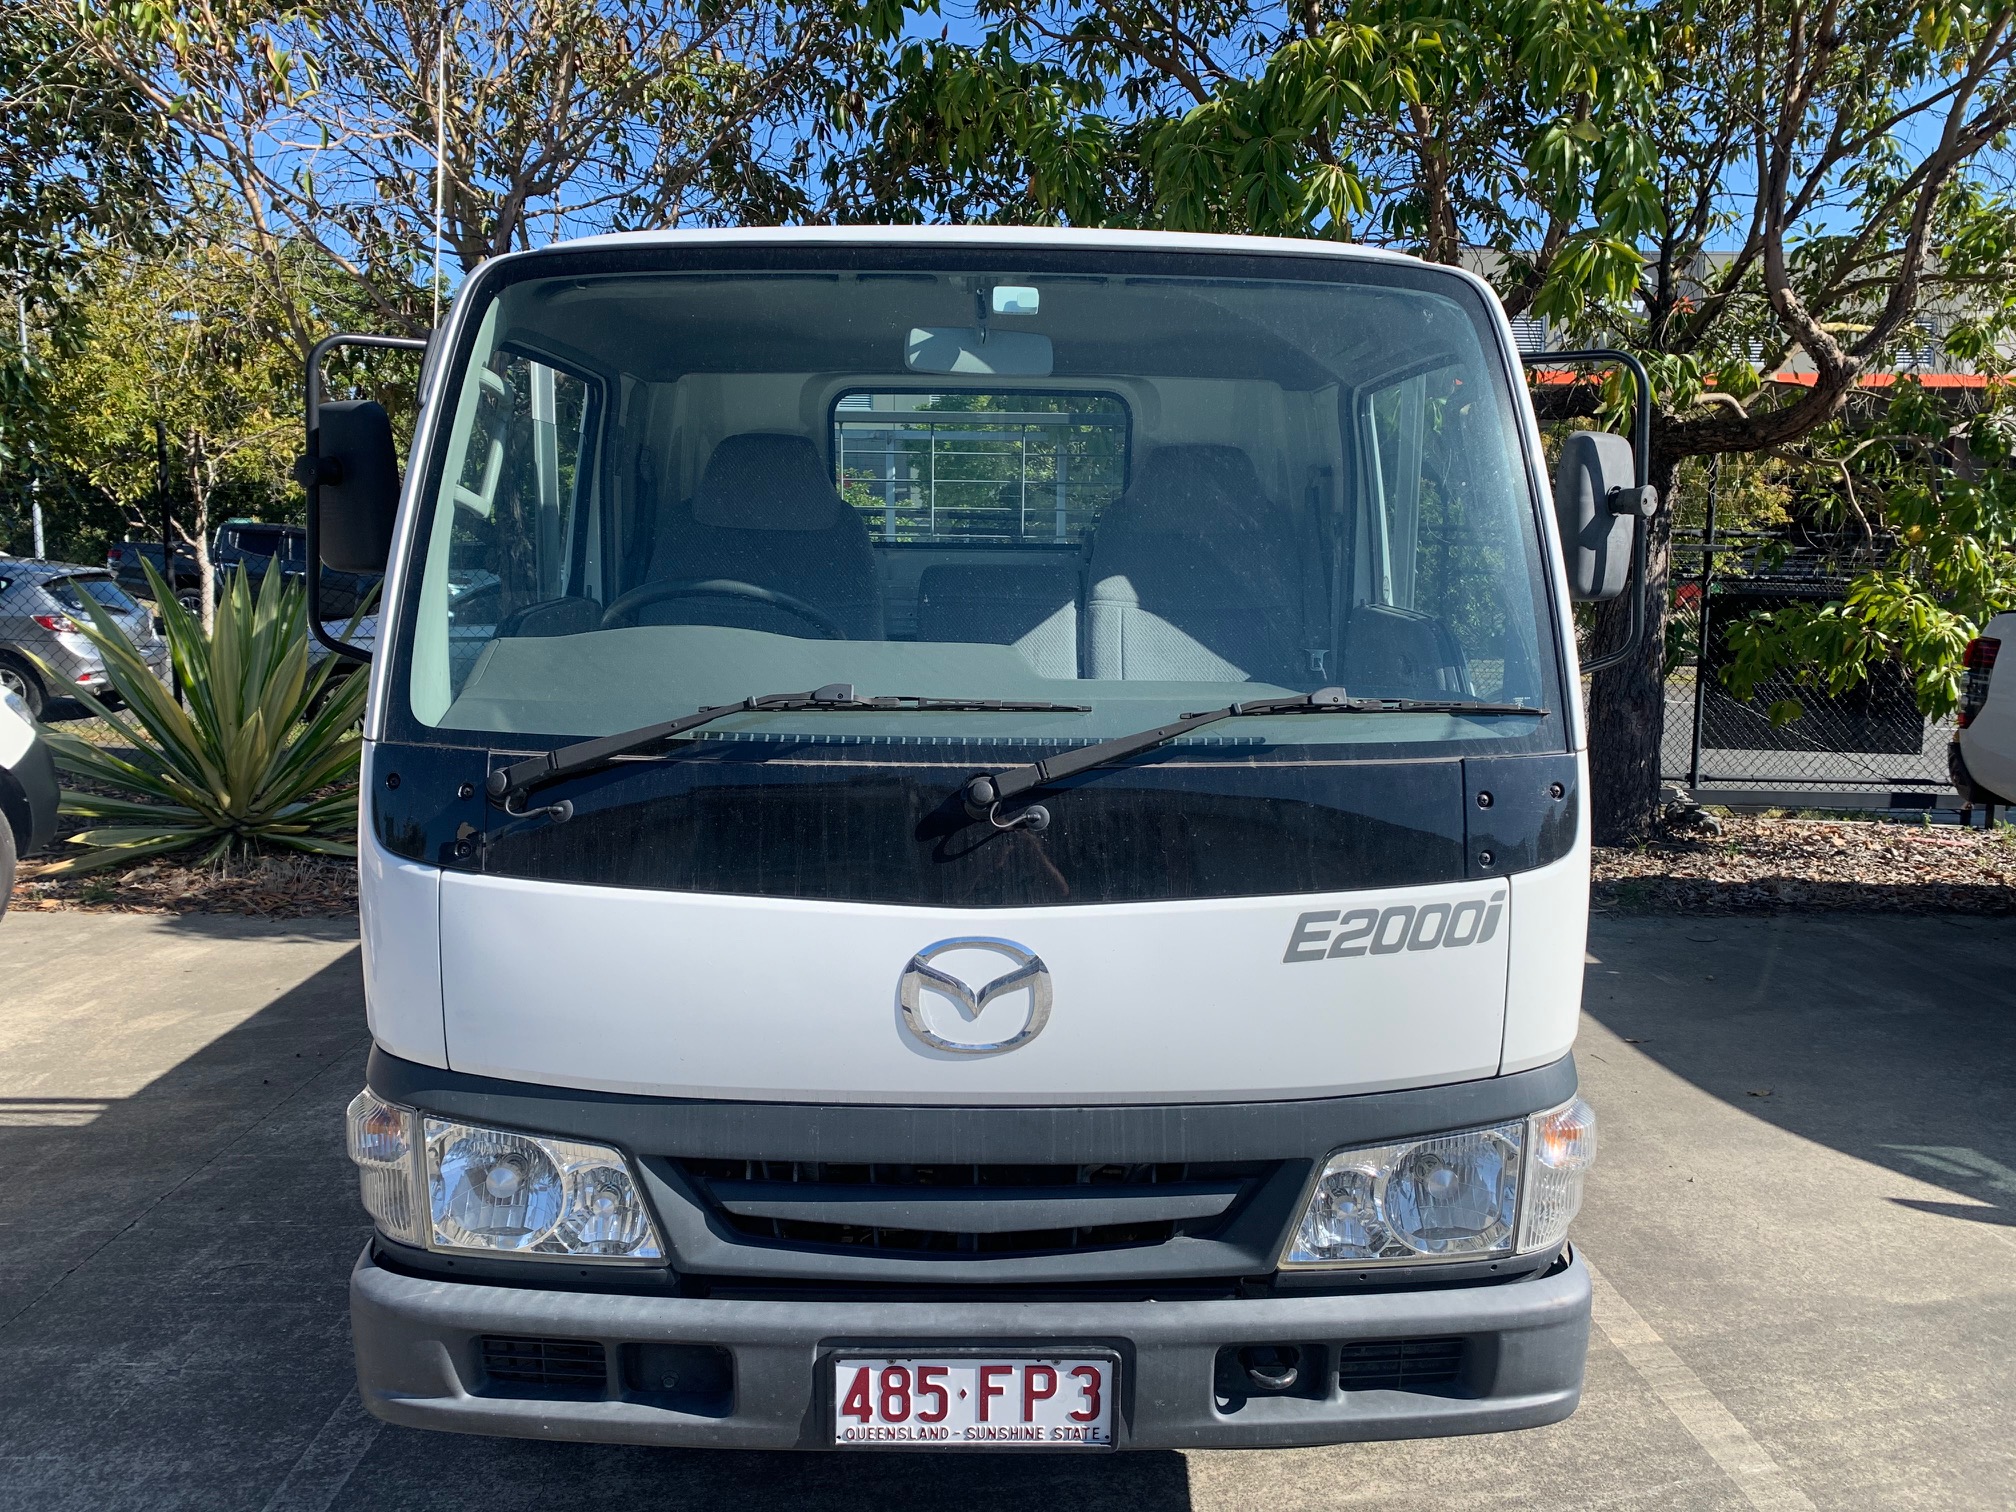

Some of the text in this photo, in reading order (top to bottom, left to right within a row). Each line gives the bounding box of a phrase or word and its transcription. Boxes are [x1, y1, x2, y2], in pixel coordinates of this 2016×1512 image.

[1282, 889, 1507, 964] E2000i
[845, 1426, 950, 1440] QUEENSLAND
[966, 1426, 1044, 1440] SUNSHINE
[1053, 1426, 1101, 1440] STATE
